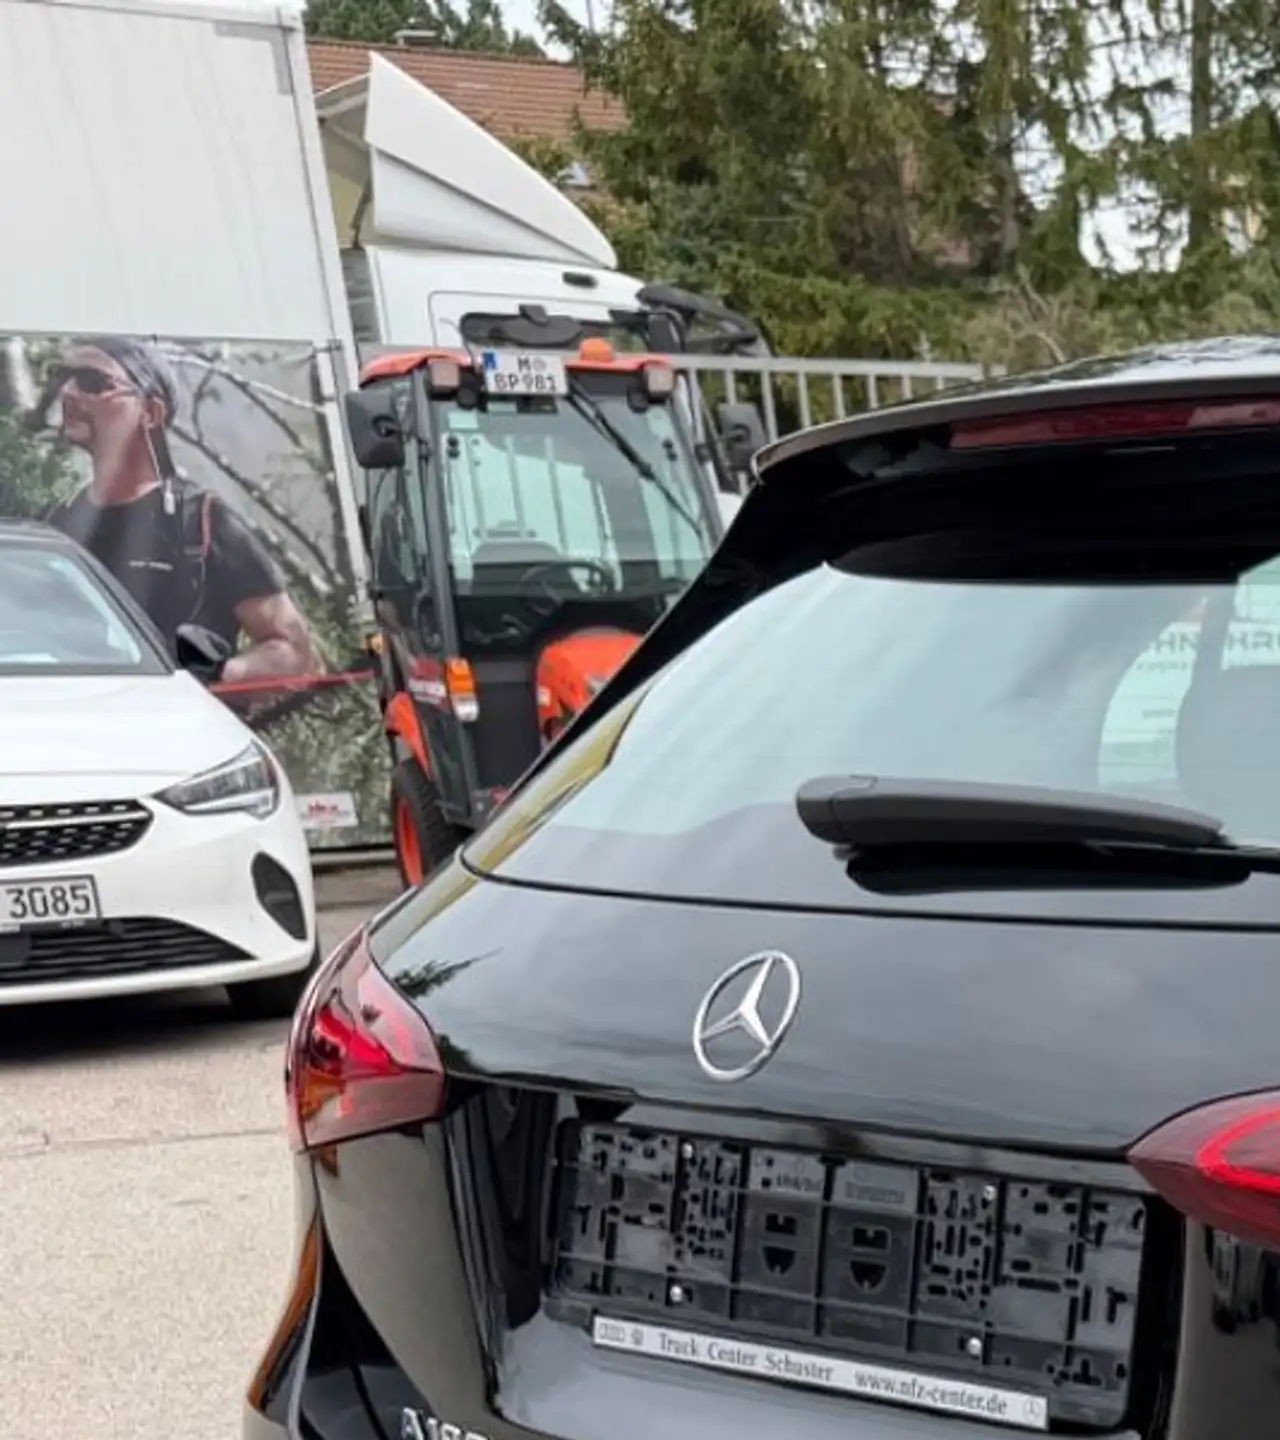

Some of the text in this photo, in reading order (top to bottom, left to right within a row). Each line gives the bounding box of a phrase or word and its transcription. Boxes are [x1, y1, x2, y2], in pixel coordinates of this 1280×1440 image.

[5, 884, 91, 918] 3085
[658, 1331, 1009, 1416] Truck Center Schuster www.nfz-center.de
